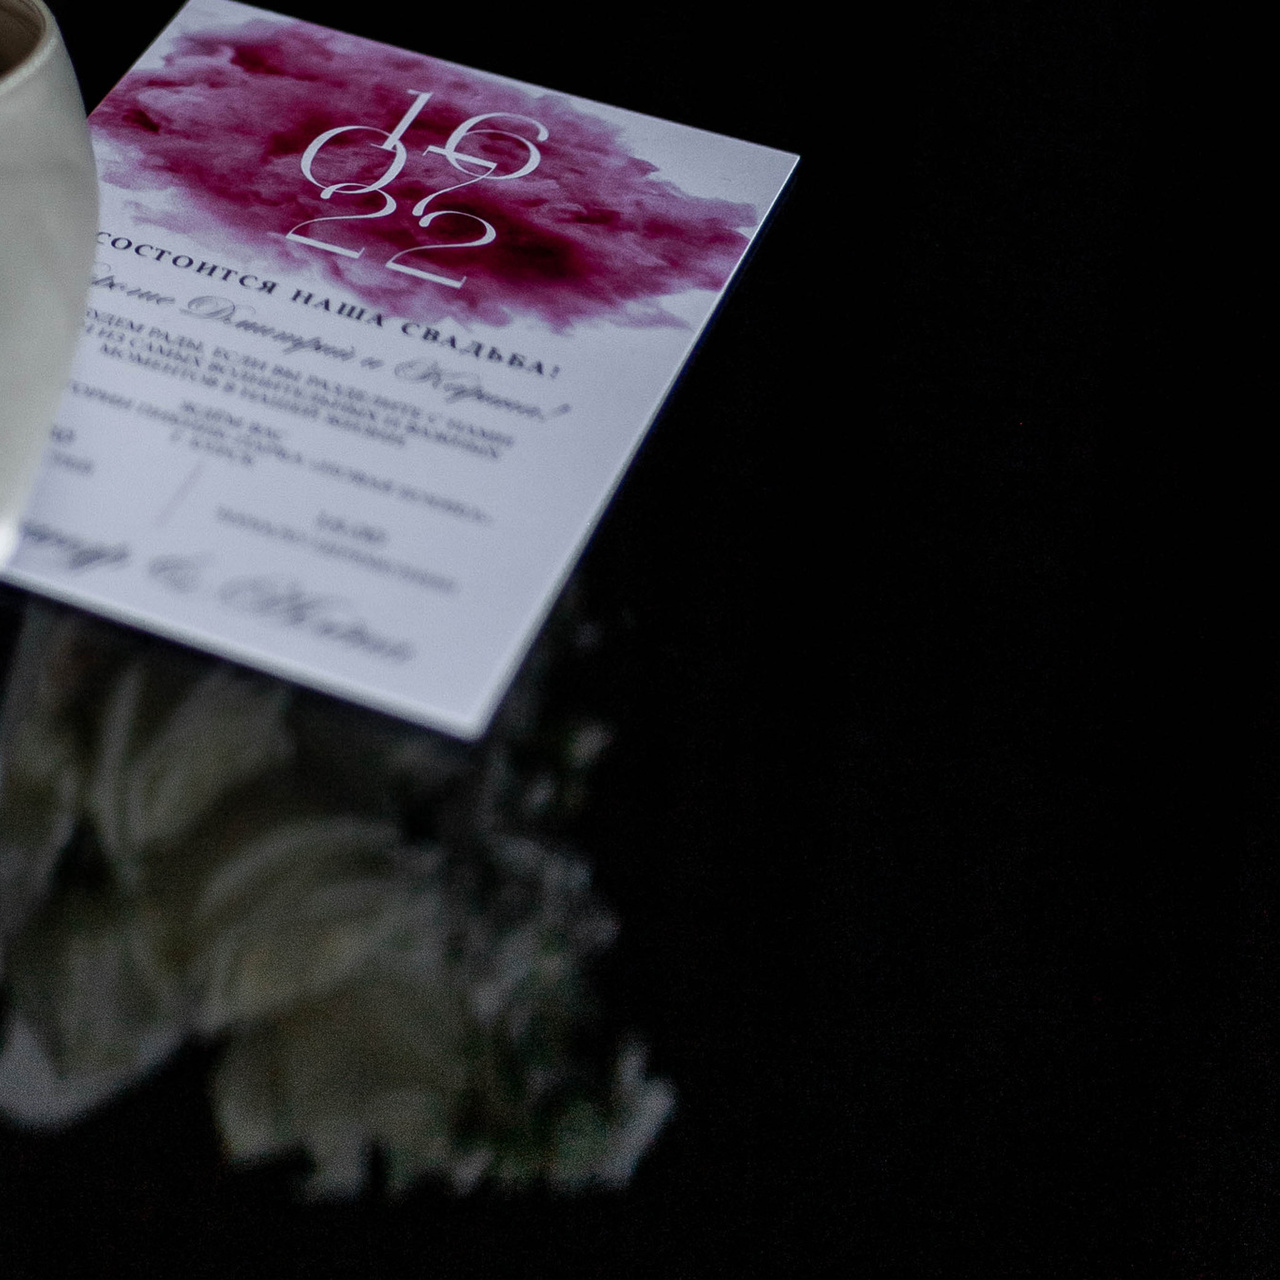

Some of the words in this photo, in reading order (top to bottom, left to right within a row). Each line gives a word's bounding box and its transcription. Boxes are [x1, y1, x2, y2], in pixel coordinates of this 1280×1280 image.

[285, 182, 497, 290] 22
[97, 231, 278, 296] СОСТОИТСЯ
[291, 287, 384, 330] НАША
[401, 321, 561, 381] СВАДЬБА!
